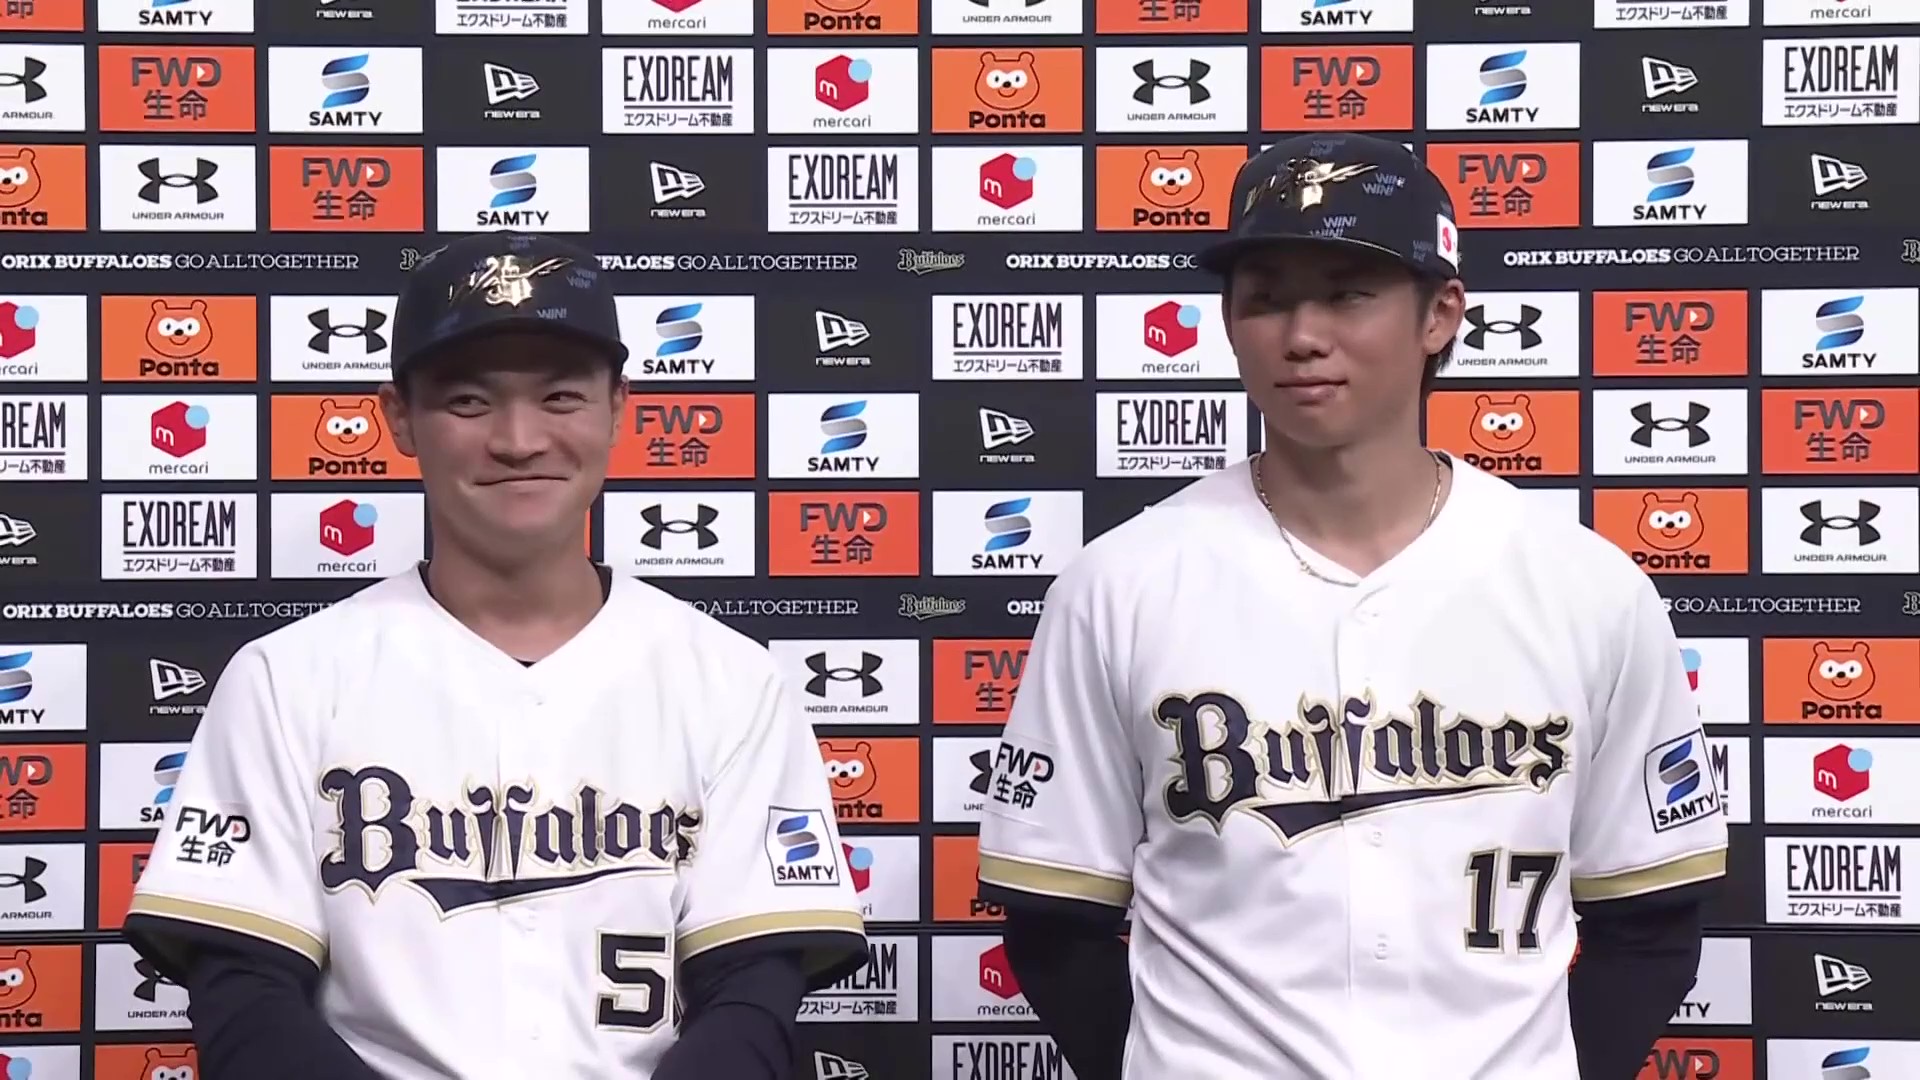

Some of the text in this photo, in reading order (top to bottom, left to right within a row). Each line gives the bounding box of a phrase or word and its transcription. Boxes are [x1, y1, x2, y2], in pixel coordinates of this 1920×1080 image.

[139, 10, 212, 25] SAMTY
[962, 15, 1052, 23] UNDER ARMOUR
[1301, 11, 1372, 25] SAMTY
[1616, 3, 1727, 20] エクスドリーム不動産
[1811, 6, 1871, 18] mercari
[458, 13, 567, 28] エクスドリーム不動産
[648, 18, 706, 28] mercari
[804, 10, 881, 30] Ponta
[132, 57, 221, 87] FWD
[1293, 56, 1380, 86] FWD
[1785, 45, 1898, 93] EXDREAM
[624, 56, 732, 102] EXDREAM
[144, 90, 207, 120] 生命
[1304, 89, 1367, 119] 生命
[1784, 103, 1897, 117] エクスドリーム不動産
[2, 111, 53, 120] ARMOUR
[310, 111, 382, 126] SAMTY
[624, 113, 732, 126] エクスドリーム不動産
[813, 116, 871, 127] mercari
[969, 108, 1045, 128] Ponta
[1126, 112, 1217, 121] UNDER ARMOUR
[1467, 108, 1538, 123] SAMTY
[303, 158, 391, 188] FWD
[789, 154, 897, 200] EXDREAM
[1459, 154, 1547, 184] FWD
[1362, 183, 1393, 196] WIN!
[313, 190, 377, 220] 生命
[1470, 186, 1533, 216] 生命
[132, 211, 225, 221] UNDER ARMOUR
[477, 211, 548, 225] SAMTY
[790, 207, 897, 224] エクスドリーム不動産
[978, 214, 1035, 225] mercari
[1133, 206, 1210, 226] Ponta
[1634, 205, 1706, 220] SAMTY
[1323, 216, 1357, 228] WIN!
[2, 255, 51, 268] ORIX
[55, 255, 172, 268] BUFFALOES
[594, 255, 675, 270] FALOES
[1006, 255, 1052, 268] ORIX
[1056, 255, 1170, 268] BUFFALOES
[1504, 251, 1551, 265] ORIX
[1555, 249, 1671, 264] BUFFALOES
[537, 308, 567, 319] WIN!
[1626, 302, 1715, 332] FWD
[954, 303, 1062, 348] EXDREAM
[1636, 334, 1701, 364] 生命
[140, 356, 219, 376] Ponta
[301, 361, 392, 371] UNDER ARMOUR
[643, 360, 714, 374] SAMTY
[954, 359, 1061, 372] エクスドリーム不動産
[1142, 357, 1199, 373] mercari
[1456, 357, 1548, 366] UNDER ARMOUR
[1803, 353, 1876, 368] SAMTY
[0, 363, 38, 375] rcari
[636, 405, 722, 434] FWD
[1118, 400, 1226, 445] EXDREAM
[1795, 400, 1885, 429] FWD
[2, 402, 65, 448] REAM
[647, 437, 710, 467] 生命
[1806, 432, 1871, 462] 生命
[309, 454, 387, 475] Ponta
[808, 457, 878, 471] SAMTY
[1118, 456, 1226, 470] エクスドリーム不動産
[1624, 455, 1716, 464] UNDER ARMOUR
[149, 462, 208, 474] mercari
[123, 501, 235, 547] EXDREAM
[801, 503, 887, 532] FWD
[811, 535, 873, 564] 生命
[1793, 553, 1887, 562] UNDER ARMOUR
[124, 558, 235, 572] エクスドリーム不動産
[318, 556, 376, 572] mercari
[634, 557, 725, 566] UNDER ARMOUR
[972, 554, 1043, 569] SAMTY
[3, 604, 51, 618] ORIX
[56, 604, 173, 618] BUFFALOES
[1007, 602, 1044, 616] ORI
[965, 651, 1029, 679] FW
[0, 709, 44, 724] MTY
[839, 705, 889, 713] ARMOUR
[1802, 699, 1882, 719] Ponta
[996, 742, 1054, 783] FWD
[1153, 690, 1572, 835] Buffaloes
[993, 774, 1038, 810] 生命
[834, 802, 882, 818] nta
[1657, 793, 1714, 826] SAMTY
[1812, 801, 1872, 818] mercari
[175, 806, 251, 842] FWD
[319, 764, 700, 906] Buffaloes
[176, 840, 236, 868] 生命
[777, 865, 834, 881] SAMTY
[1787, 845, 1901, 892] EXDREAM
[1464, 848, 1564, 954] 17
[0, 911, 53, 920] ARMOUR
[1788, 903, 1901, 917] エクスドリーム不動産
[596, 928, 678, 1034] 5
[127, 1010, 167, 1019] UNDER
[798, 1001, 897, 1015] クスドリーム不動産
[1648, 1049, 1719, 1080] WD
